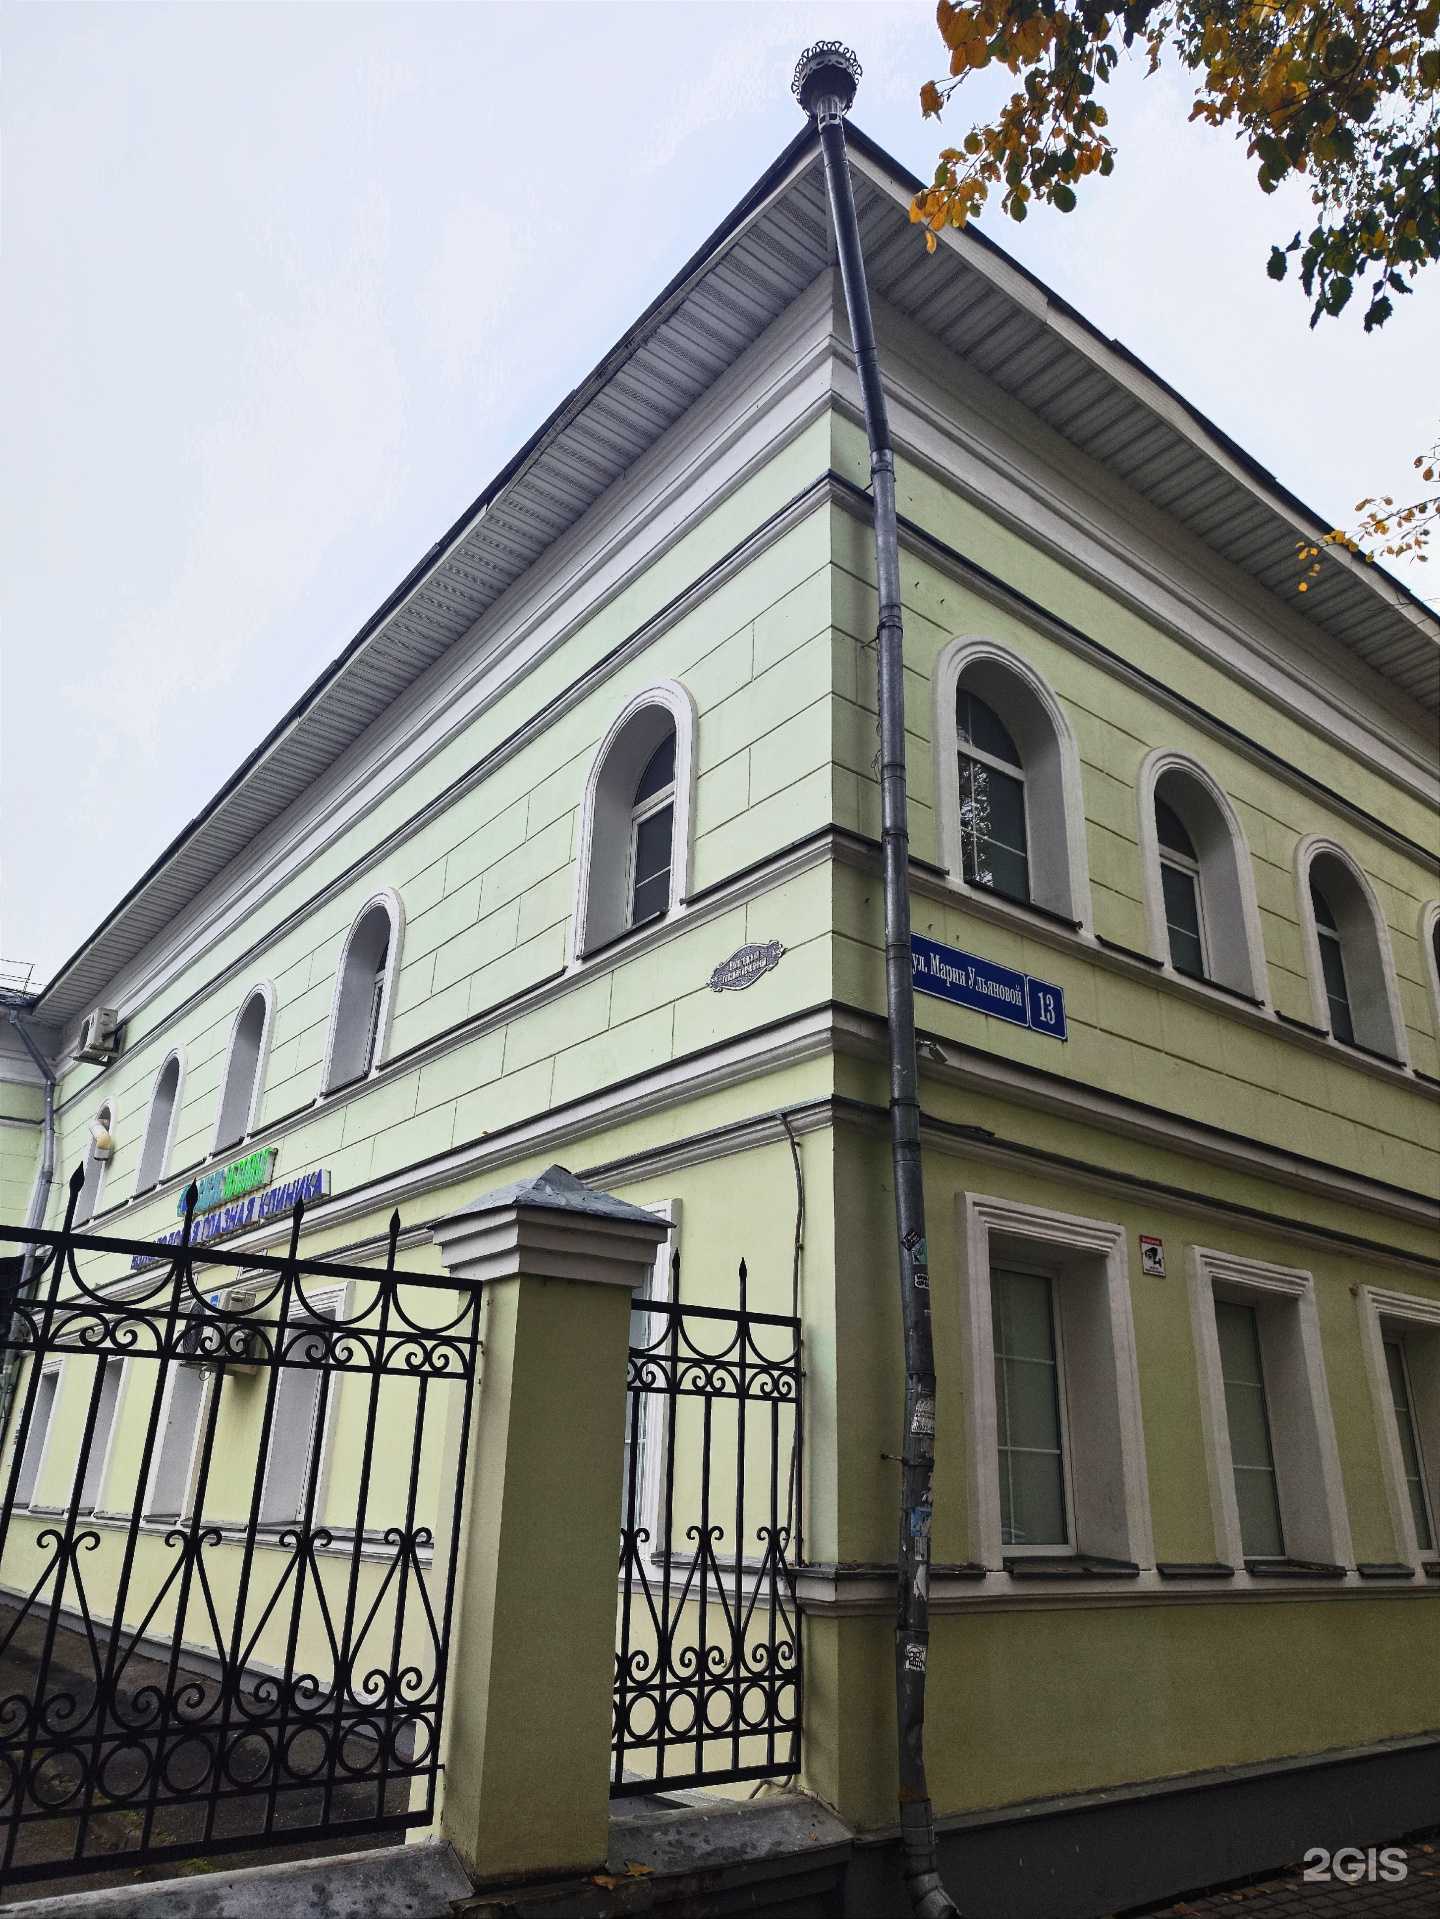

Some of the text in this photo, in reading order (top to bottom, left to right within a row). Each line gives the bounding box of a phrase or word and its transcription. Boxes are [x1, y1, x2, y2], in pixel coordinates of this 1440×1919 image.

[911, 953, 1023, 1007] ул. Марии Ульяновой
[1038, 991, 1056, 1025] 13
[259, 1168, 323, 1219] КЛИНИКА
